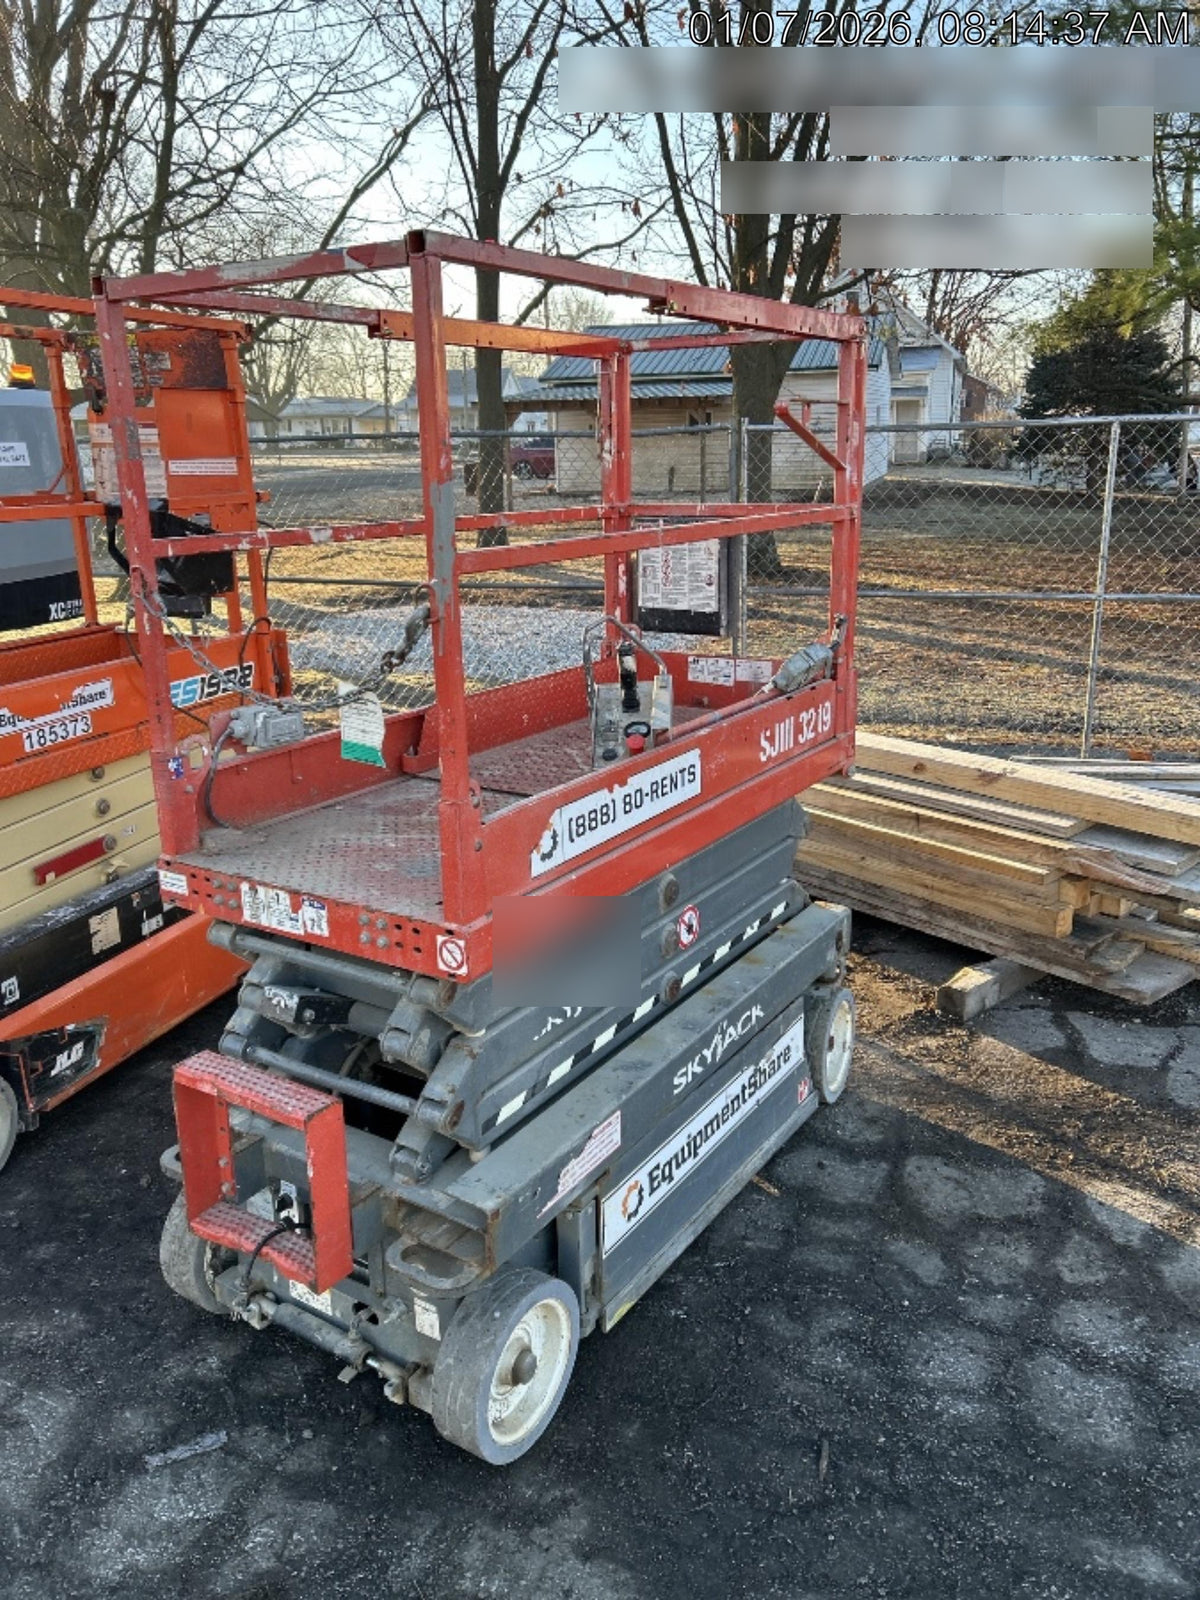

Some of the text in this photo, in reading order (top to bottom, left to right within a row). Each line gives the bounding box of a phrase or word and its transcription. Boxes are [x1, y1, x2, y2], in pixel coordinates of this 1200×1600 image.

[25, 715, 92, 749] 185373
[798, 701, 831, 744] 3219
[568, 764, 697, 843] (888) 80-RENTS
[673, 1004, 765, 1095] SKYJACK
[648, 1045, 792, 1197] EquipmentShare
